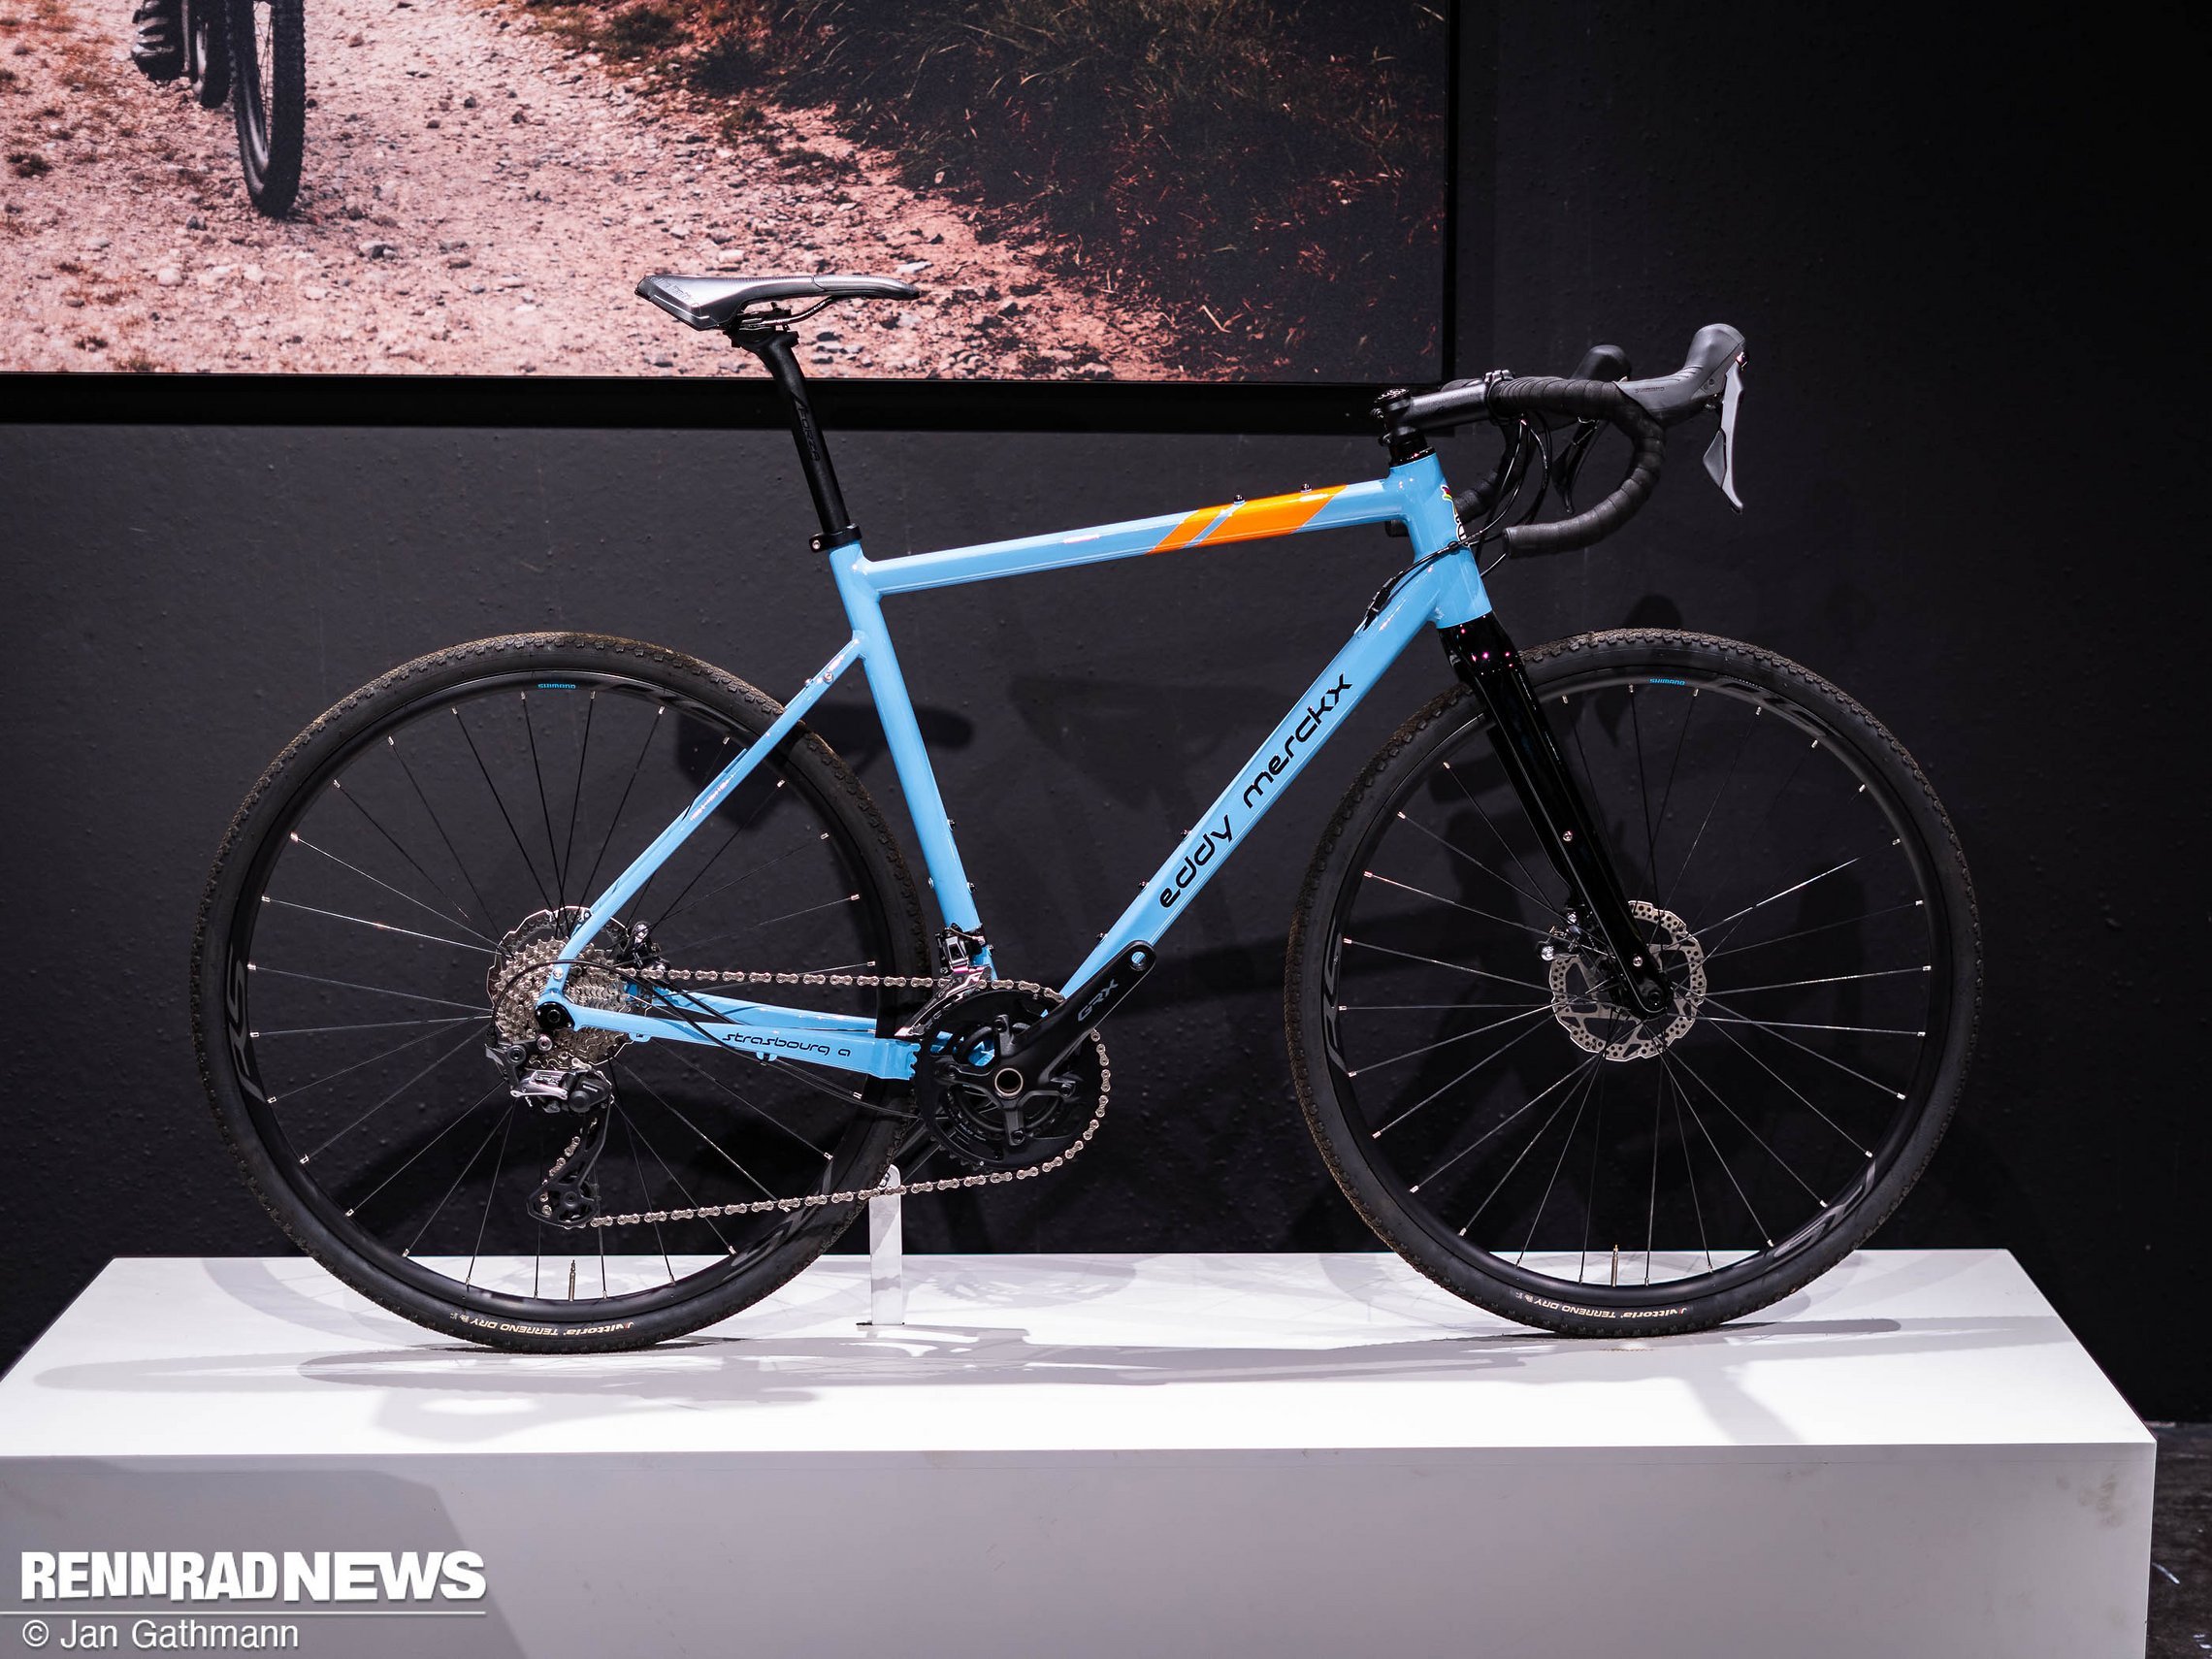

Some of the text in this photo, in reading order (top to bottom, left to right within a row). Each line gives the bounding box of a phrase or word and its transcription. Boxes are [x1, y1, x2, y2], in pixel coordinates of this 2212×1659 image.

[1159, 673, 1353, 908] eddy merckx
[1077, 978, 1119, 1022] GRX
[722, 1032, 831, 1057] strasbourg
[1534, 1298, 1560, 1310] DRY
[1561, 1305, 1616, 1318] TERRENO
[470, 1317, 498, 1330] DRY
[500, 1323, 560, 1337] TERRENO
